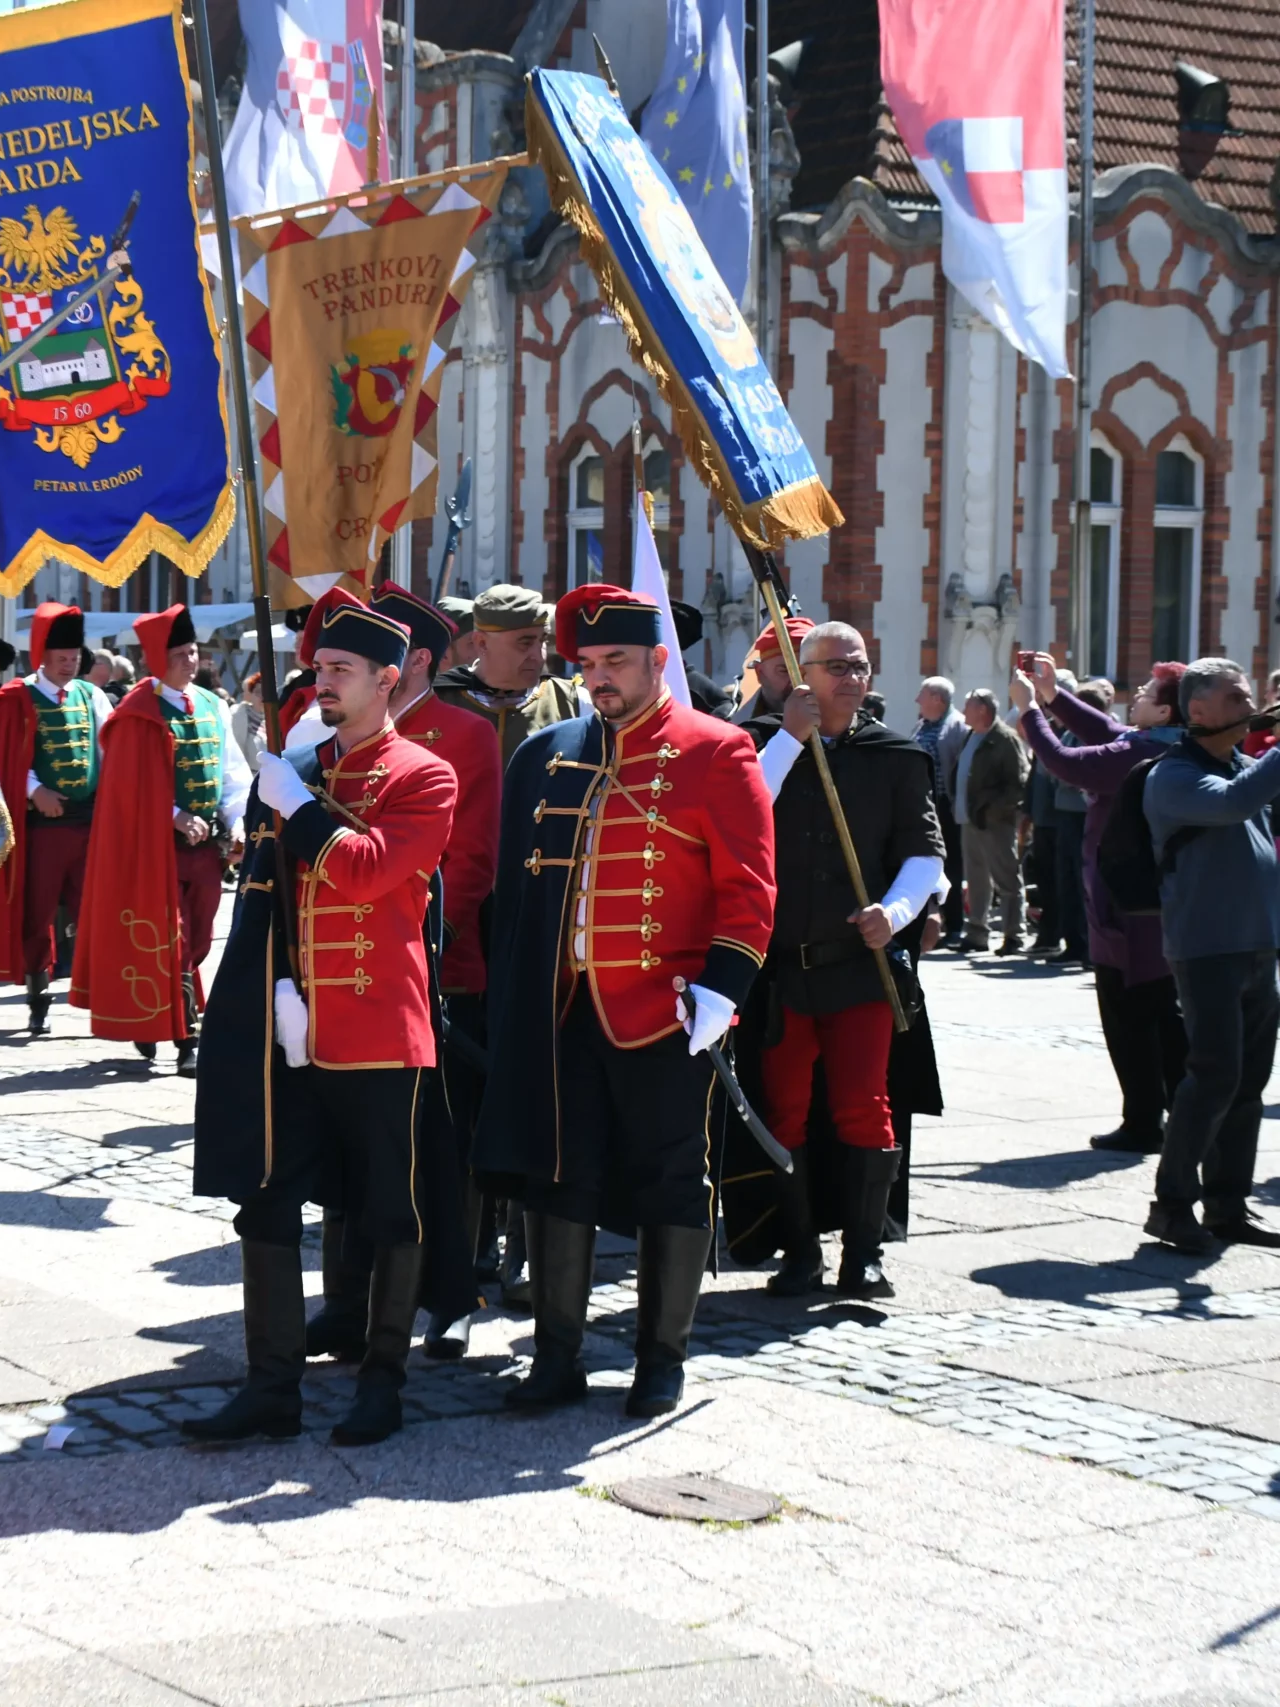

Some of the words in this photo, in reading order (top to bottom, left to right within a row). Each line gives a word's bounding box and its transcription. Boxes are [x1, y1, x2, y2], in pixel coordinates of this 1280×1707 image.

[11, 85, 94, 105] POSTROJBA
[302, 253, 442, 301] TRENKOVI
[322, 283, 438, 321] PANDURI
[33, 478, 79, 492] PETAR
